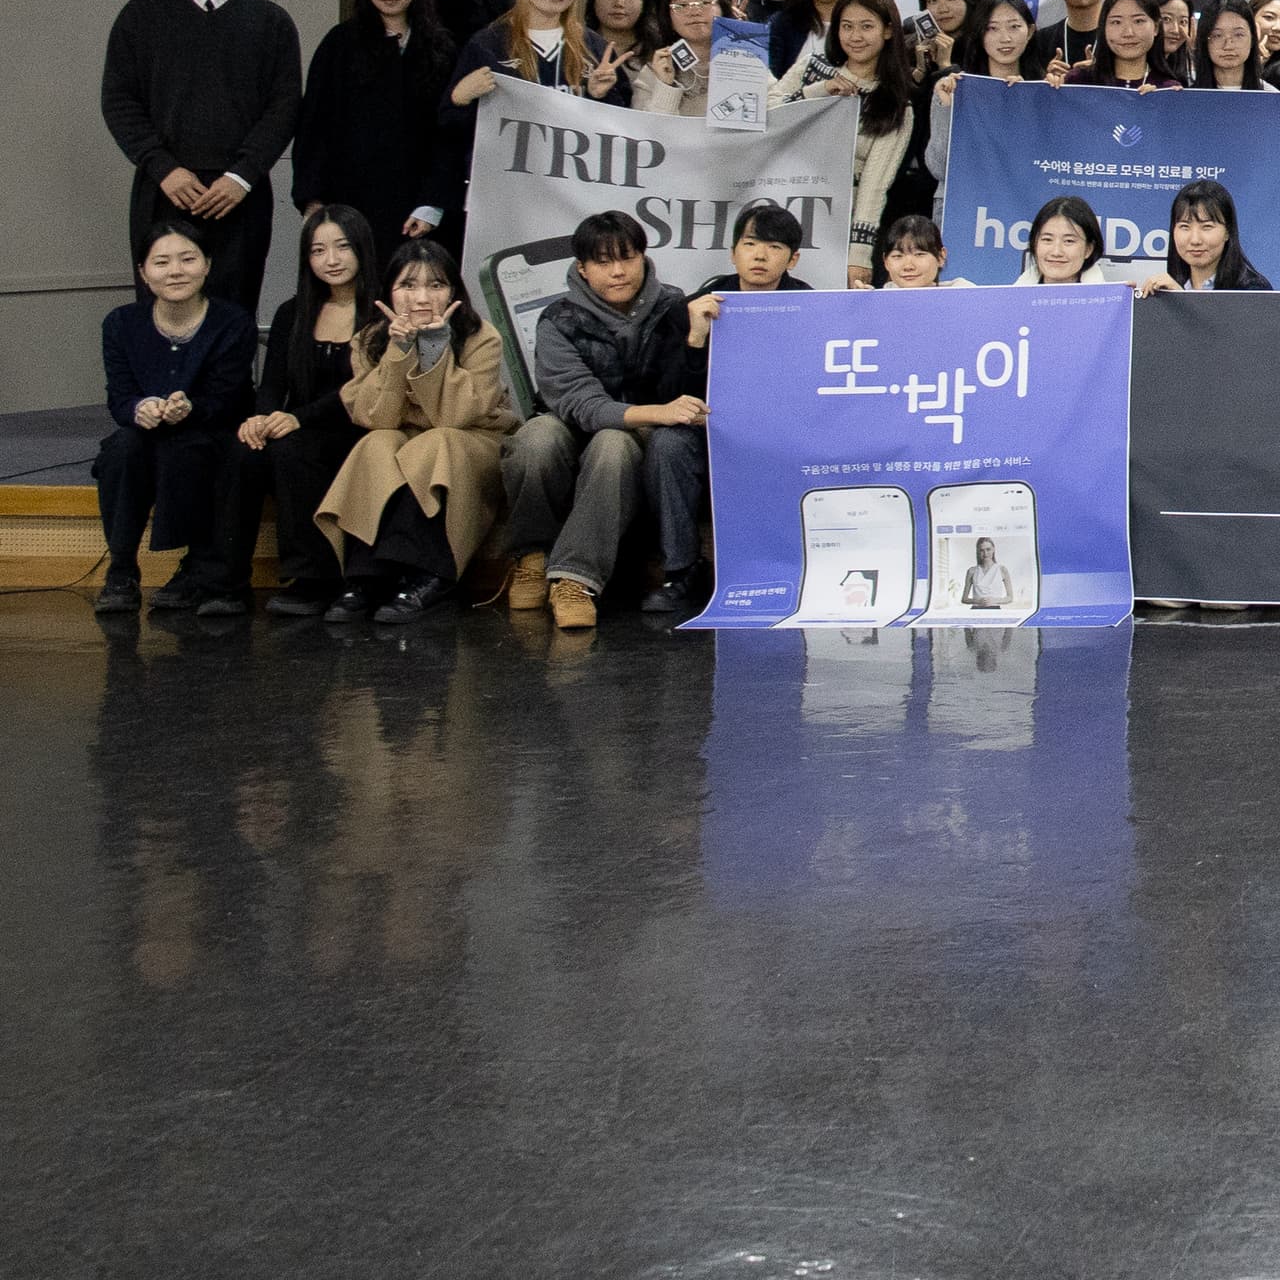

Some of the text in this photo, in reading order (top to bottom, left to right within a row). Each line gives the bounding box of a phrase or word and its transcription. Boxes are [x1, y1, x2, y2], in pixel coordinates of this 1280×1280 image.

[499, 117, 666, 189] TRIP
[1072, 163, 1193, 180] 음성으로 모두의 진료를
[635, 195, 833, 251] SHT
[982, 457, 1001, 468] 연습
[1003, 455, 1032, 467] 서비스
